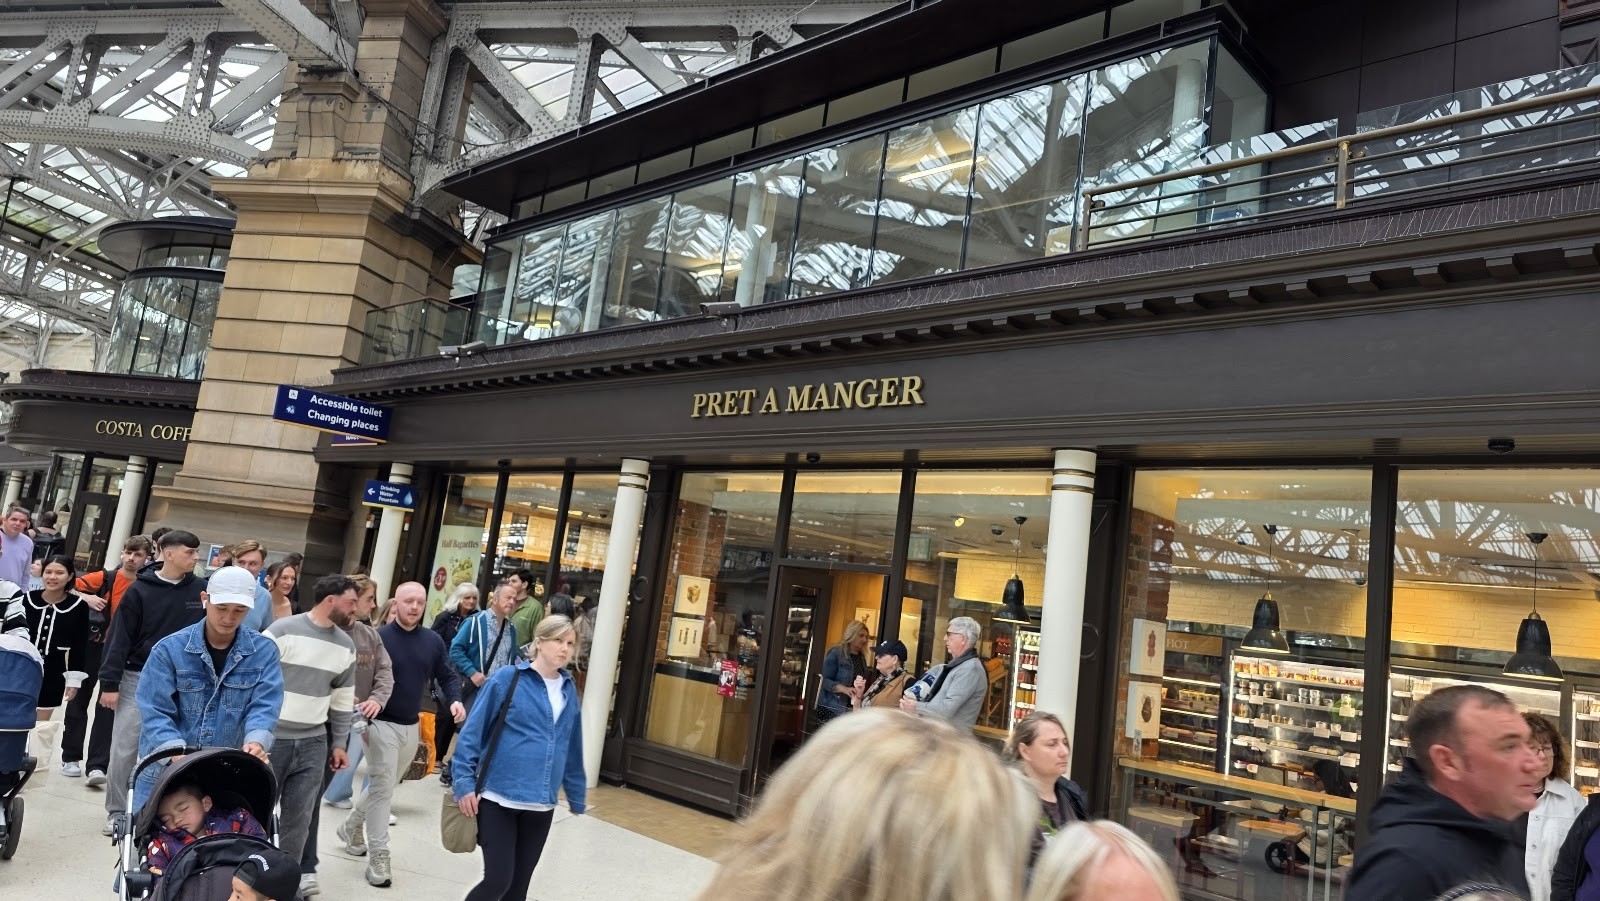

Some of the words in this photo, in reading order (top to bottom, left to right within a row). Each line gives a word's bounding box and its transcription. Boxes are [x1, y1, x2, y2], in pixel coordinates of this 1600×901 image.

[690, 389, 757, 418] PRET
[759, 387, 780, 414] A
[785, 375, 924, 413] MANGER
[310, 394, 358, 413] Accessible
[360, 405, 383, 418] toilet
[95, 420, 143, 438] COSTA
[307, 409, 350, 428] Changing
[351, 419, 379, 431] places
[379, 490, 394, 498] Water
[380, 485, 400, 494] Drinking
[378, 495, 399, 504] Fountain
